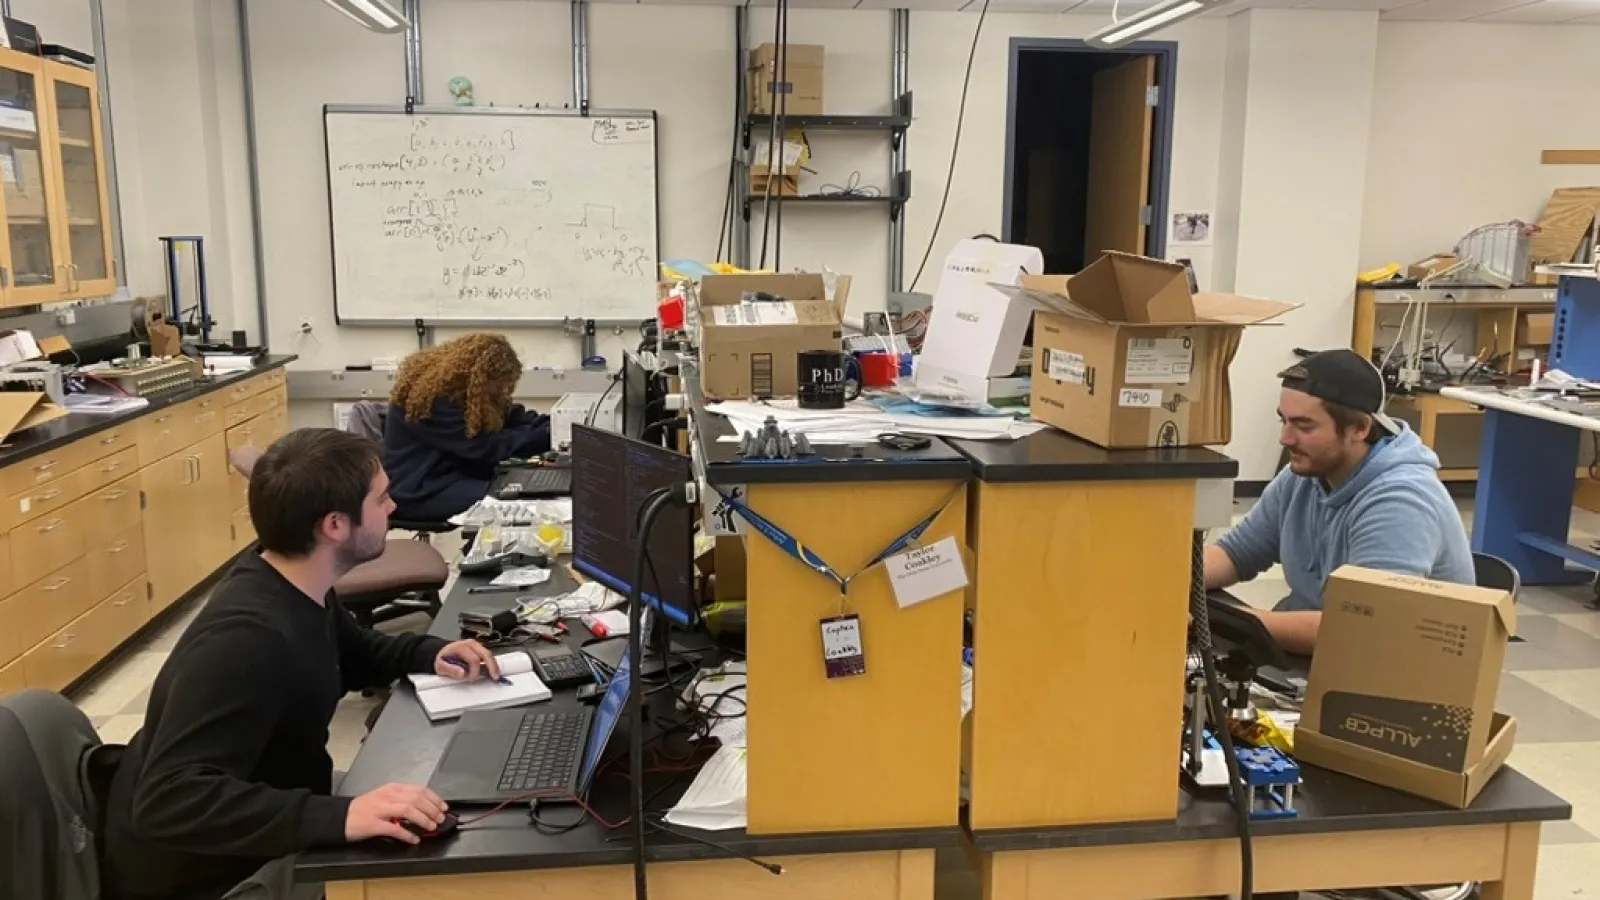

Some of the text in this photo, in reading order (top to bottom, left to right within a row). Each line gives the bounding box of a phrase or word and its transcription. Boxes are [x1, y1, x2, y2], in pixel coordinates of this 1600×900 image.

[811, 367, 845, 383] PhD
[904, 554, 941, 571] Coakley
[1344, 717, 1423, 748] ALLPCB
